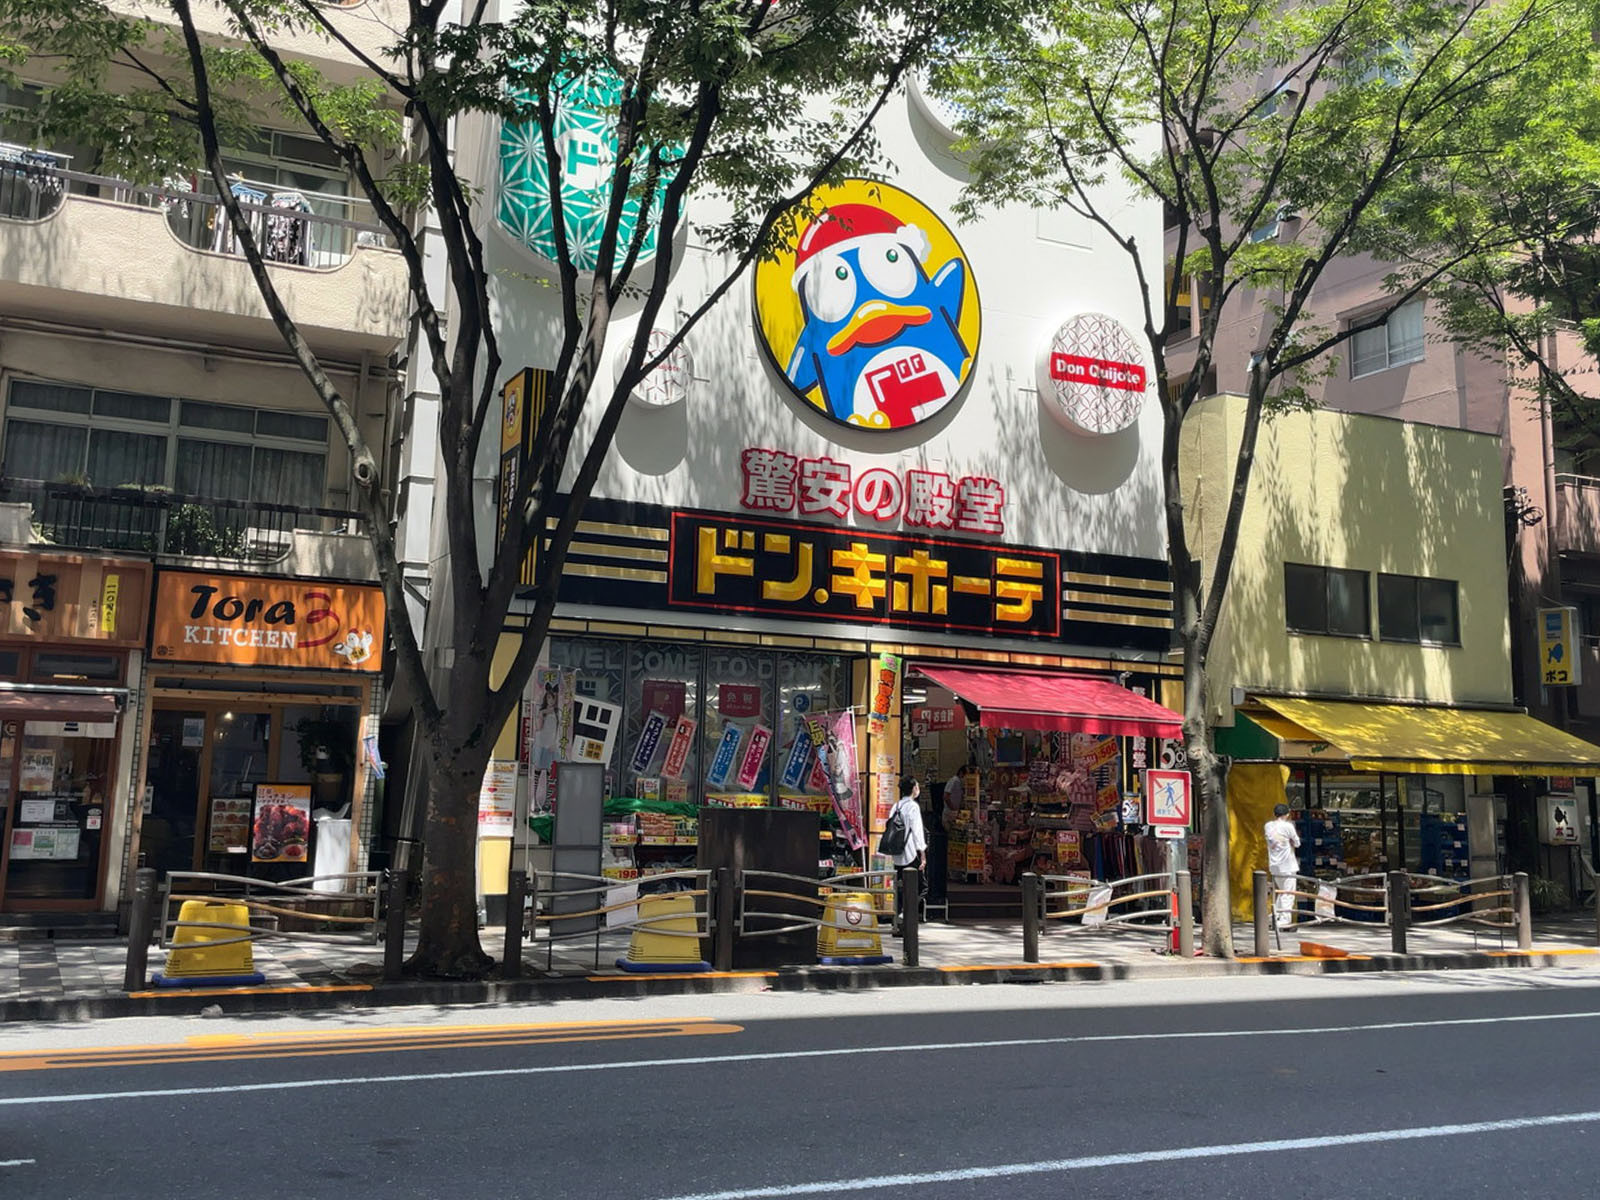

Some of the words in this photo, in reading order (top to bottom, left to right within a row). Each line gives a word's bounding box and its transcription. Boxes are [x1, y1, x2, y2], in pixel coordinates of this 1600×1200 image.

[1055, 358, 1086, 376] Don
[1088, 363, 1141, 385] Quijote
[741, 447, 1004, 535] 驚安の殿堂
[190, 584, 297, 626] Tora
[183, 624, 298, 649] KITCHEN
[562, 643, 701, 675] WELCOME
[711, 655, 748, 677] TO
